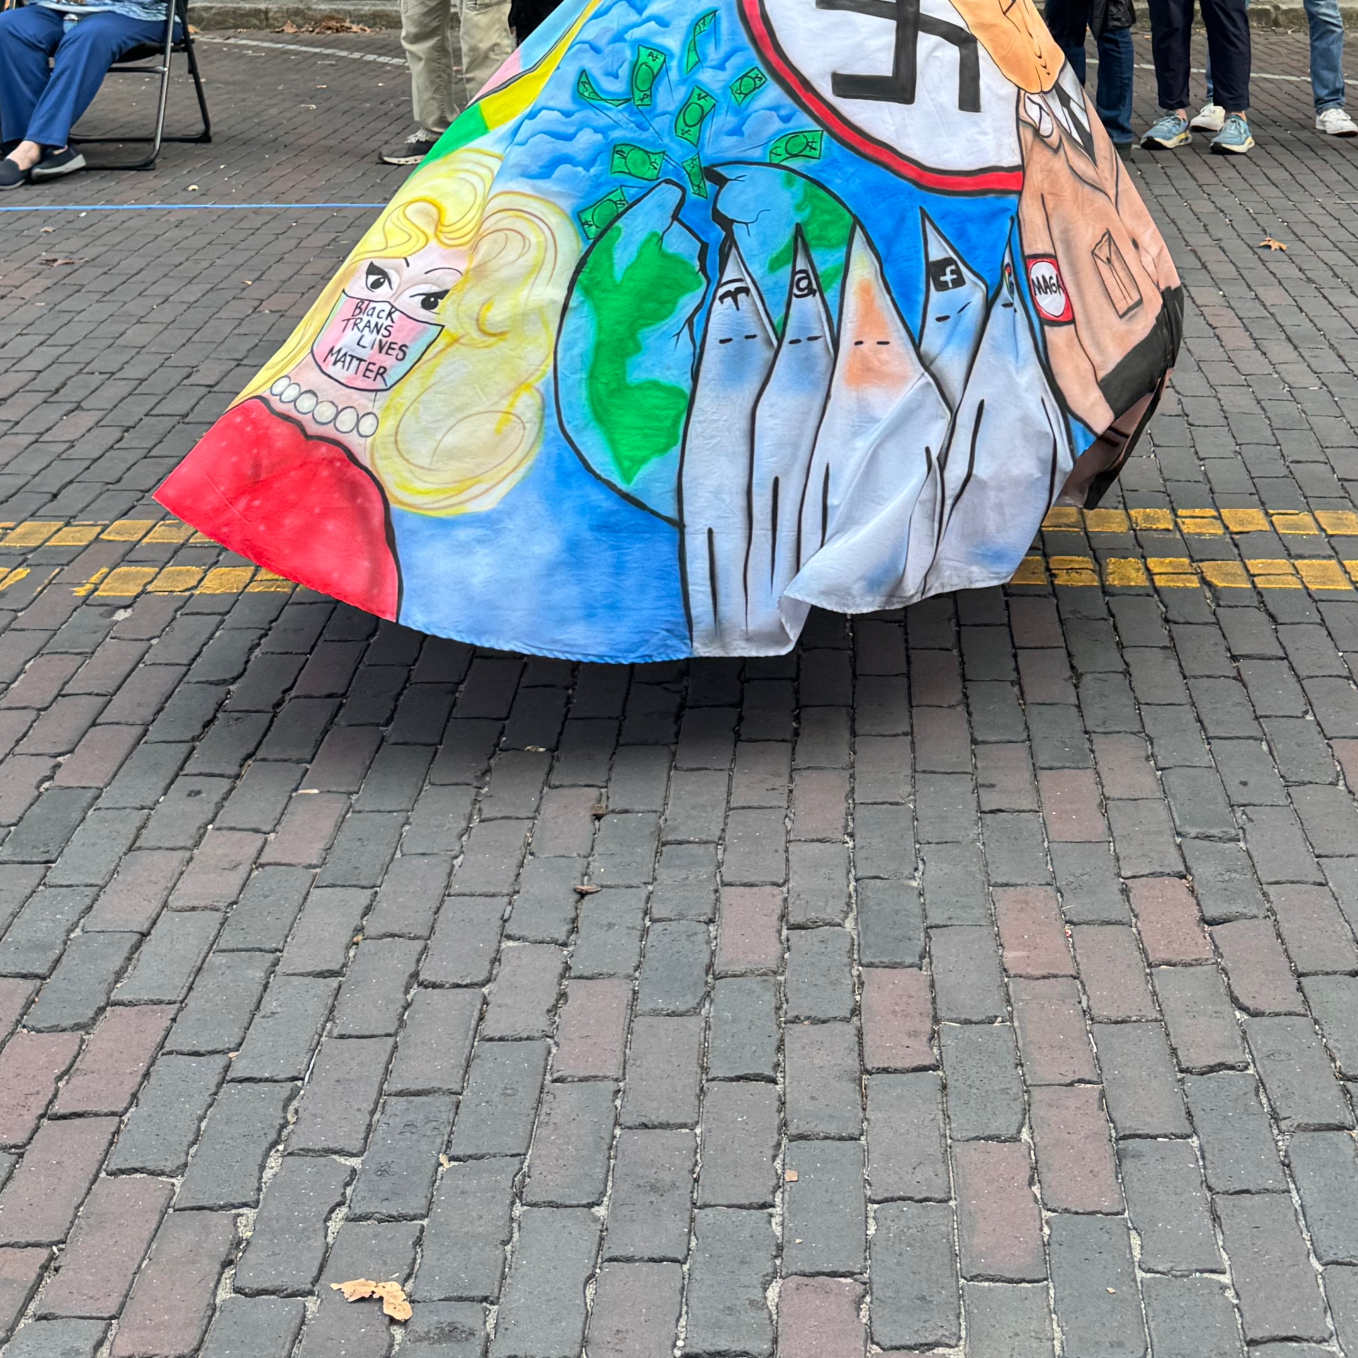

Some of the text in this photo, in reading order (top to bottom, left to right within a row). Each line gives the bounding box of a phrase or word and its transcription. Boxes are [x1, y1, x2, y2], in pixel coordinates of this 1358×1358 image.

[351, 300, 398, 323] Black
[341, 318, 394, 338] TRANS
[357, 334, 409, 361] LIVES
[323, 346, 388, 387] MATTER
